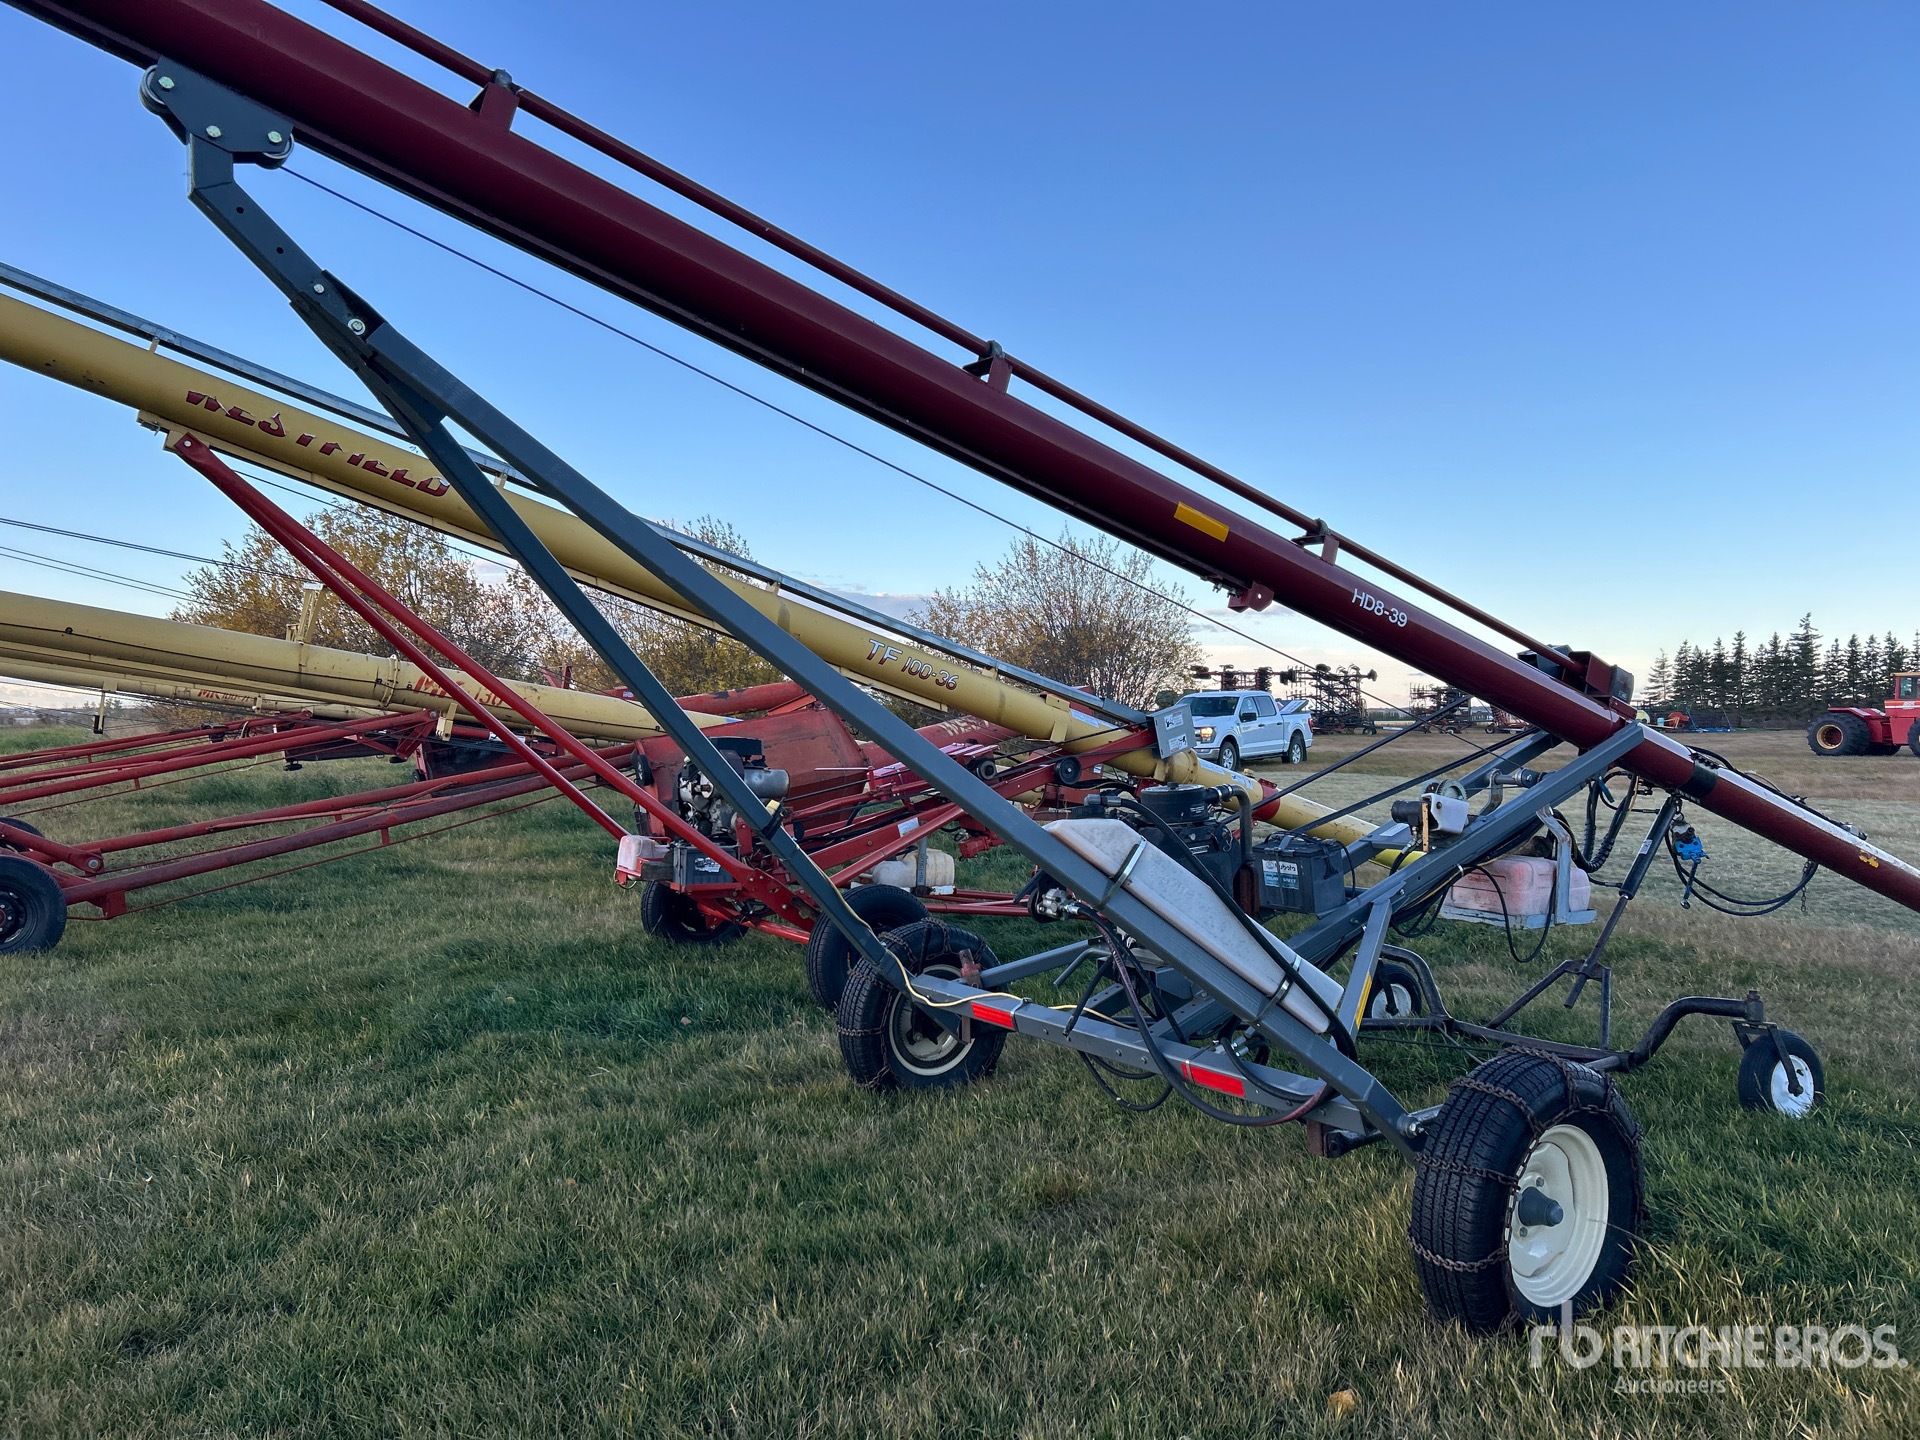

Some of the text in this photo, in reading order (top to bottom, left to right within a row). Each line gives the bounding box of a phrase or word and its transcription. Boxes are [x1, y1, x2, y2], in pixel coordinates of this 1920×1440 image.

[1351, 588, 1408, 628] HD8-39
[866, 638, 959, 691] TF 100-36
